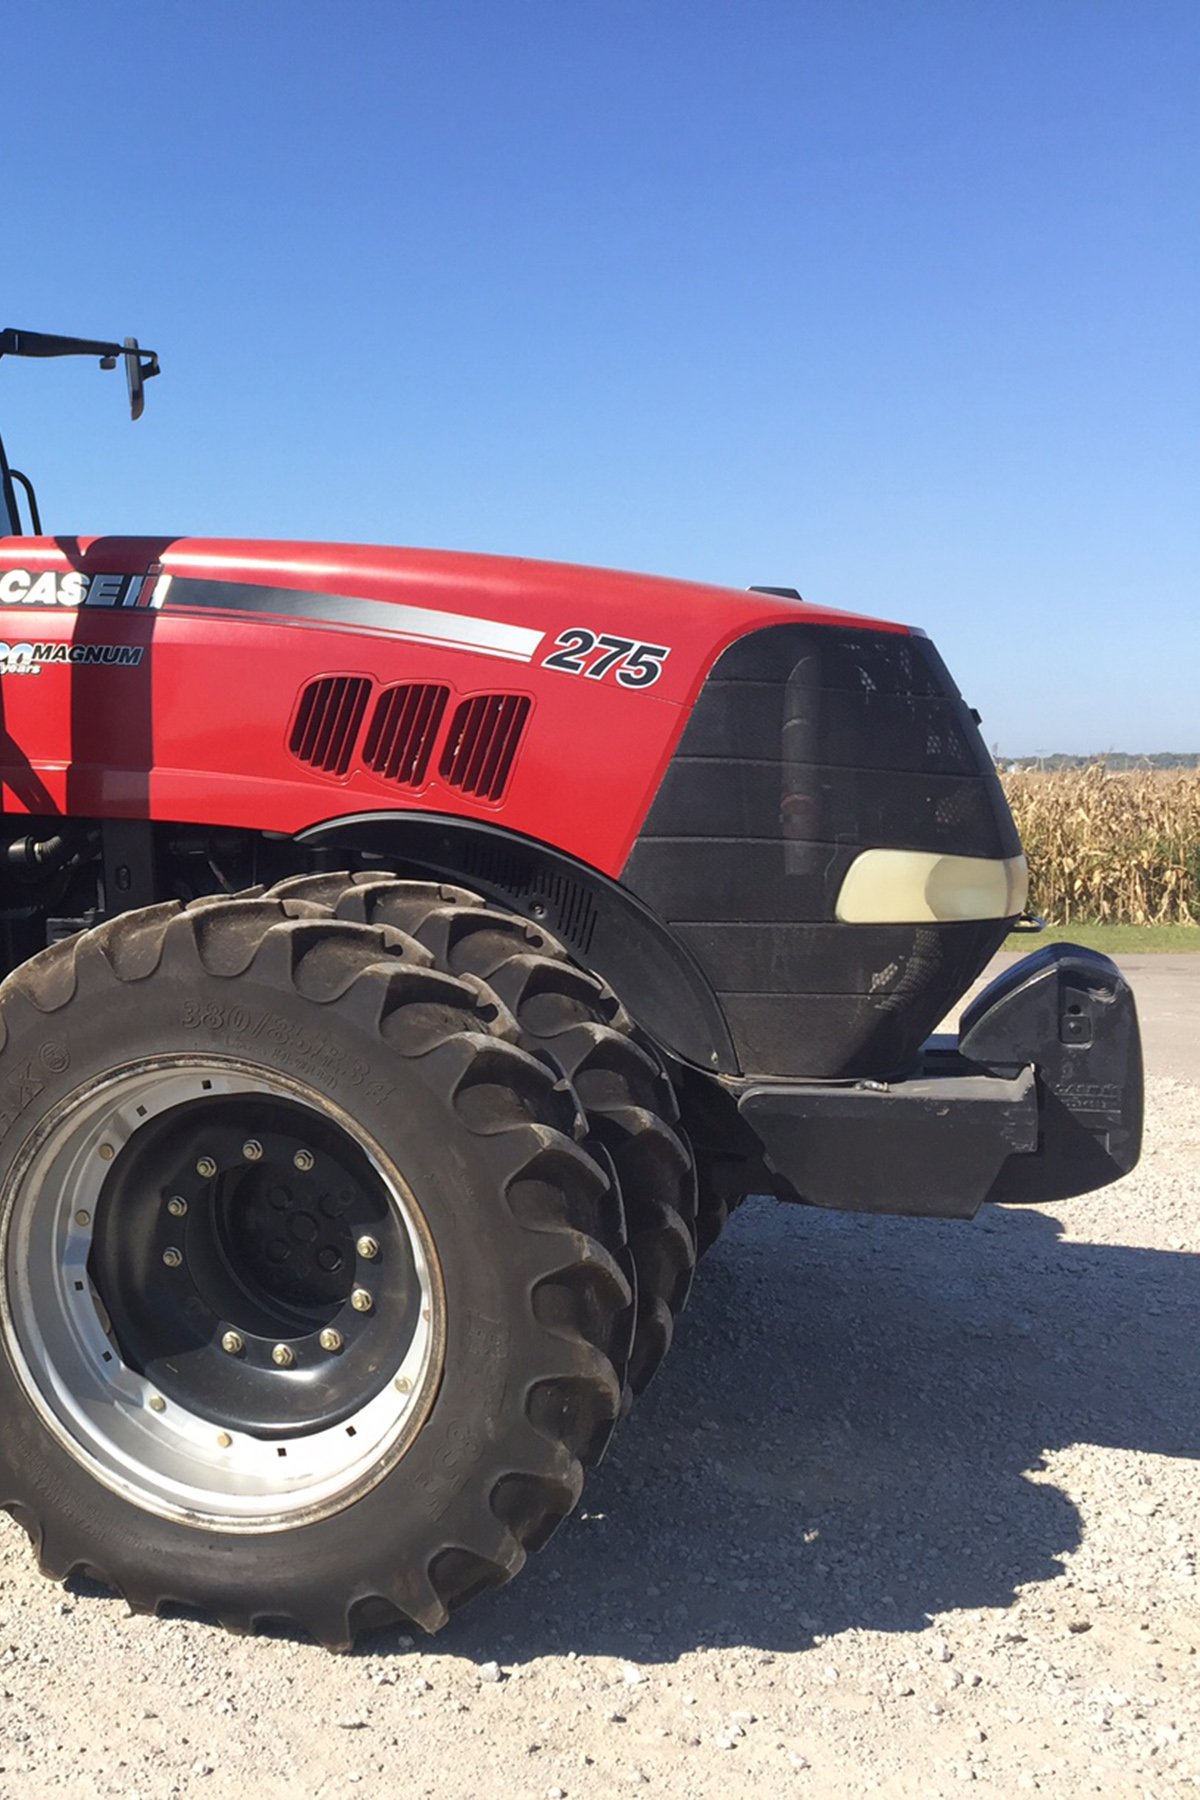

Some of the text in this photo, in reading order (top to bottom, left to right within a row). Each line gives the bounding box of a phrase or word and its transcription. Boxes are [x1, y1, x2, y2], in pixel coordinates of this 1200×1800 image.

[31, 642, 145, 666] MAGNUM
[540, 626, 672, 690] 275
[0, 660, 41, 676] years
